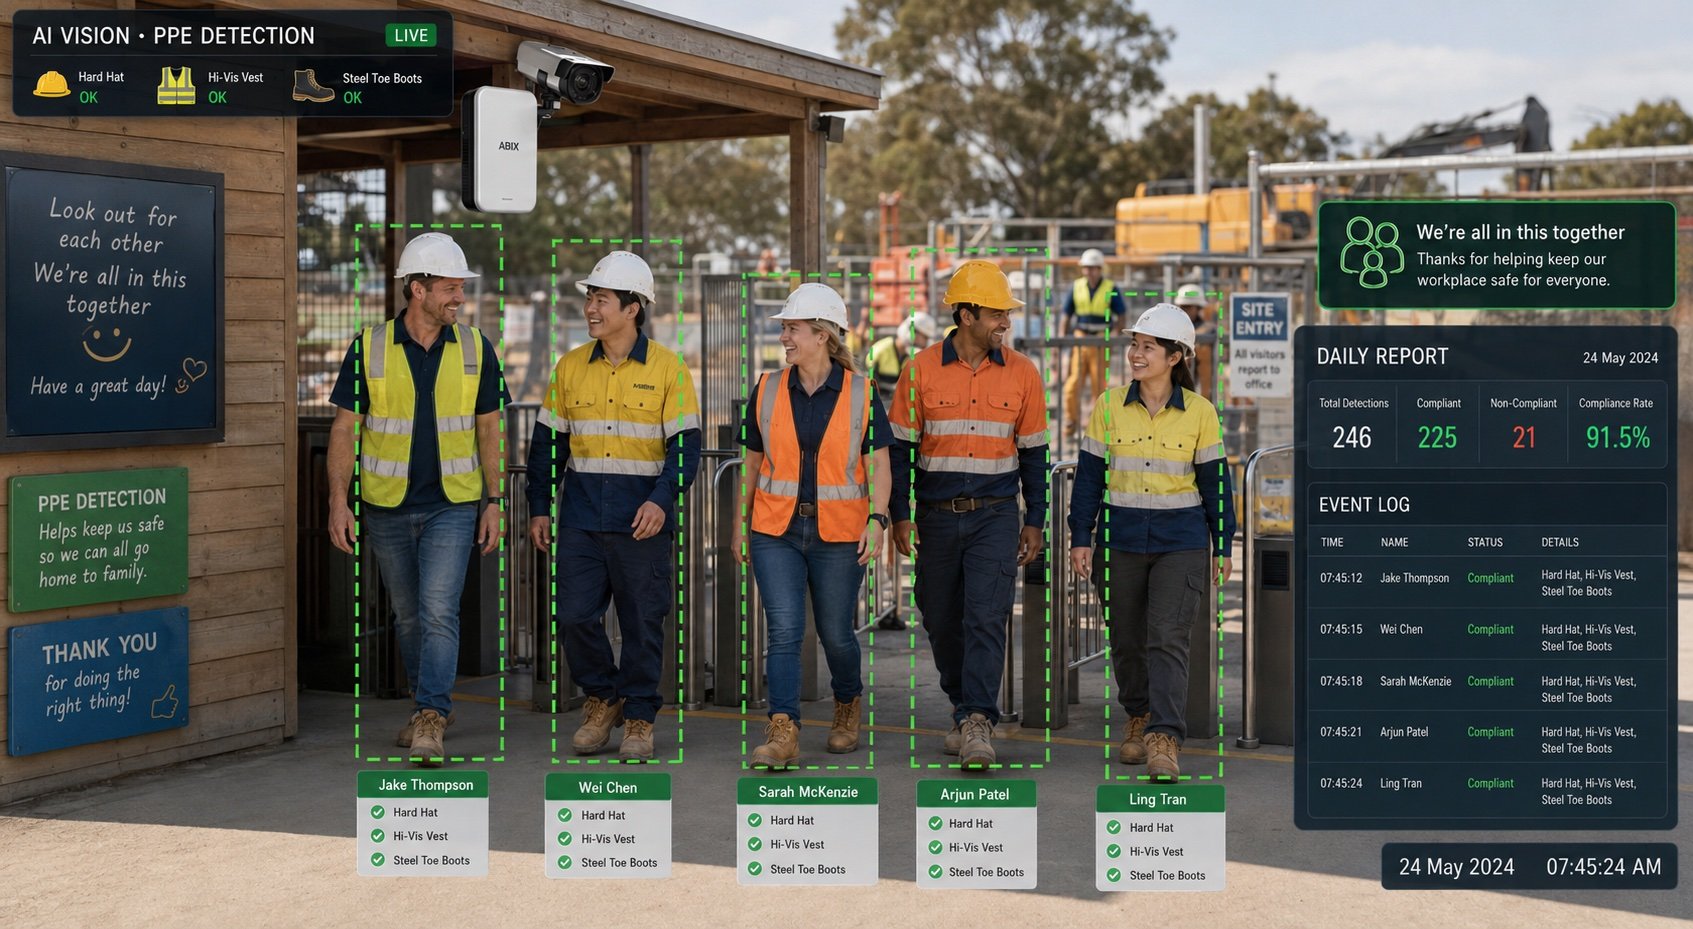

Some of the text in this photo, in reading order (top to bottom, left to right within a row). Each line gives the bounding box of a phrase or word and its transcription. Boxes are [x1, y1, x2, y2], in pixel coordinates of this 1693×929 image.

[499, 142, 519, 151] ABIX
[50, 196, 177, 227] Look out for
[59, 230, 163, 253] each other
[97, 265, 119, 286] all
[128, 268, 143, 286] in
[152, 268, 187, 288] this
[67, 294, 151, 322] together
[1242, 302, 1274, 317] SITE
[1236, 321, 1283, 335] ENTRY
[1235, 349, 1285, 359] All visitors
[1238, 365, 1280, 374] report to
[31, 375, 167, 401] Have a great day!
[1245, 379, 1272, 389] office
[38, 488, 166, 512] PPE DETECTION
[40, 515, 164, 544] Helps keep us safe
[40, 540, 150, 564] so we can all go
[40, 562, 147, 588] home to family.
[42, 632, 157, 665] THANK YOU
[45, 664, 140, 692] for doing the
[46, 687, 131, 722] right thing!
